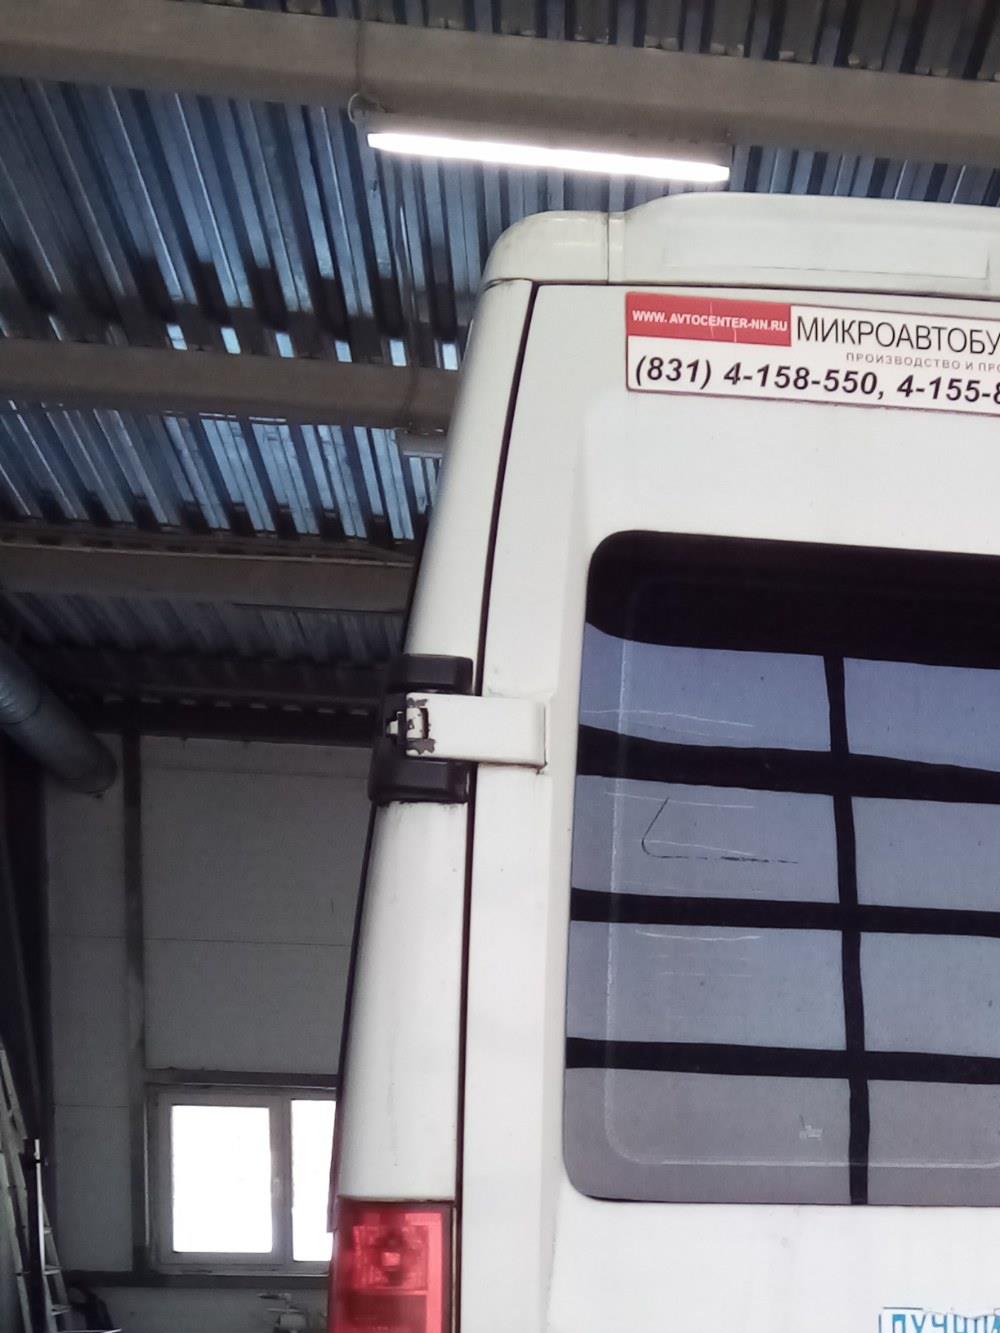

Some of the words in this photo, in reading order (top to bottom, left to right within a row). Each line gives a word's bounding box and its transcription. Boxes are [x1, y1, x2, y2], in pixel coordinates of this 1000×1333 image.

[634, 354, 713, 390] (831)
[723, 362, 885, 400] 4-158-550,
[846, 352, 961, 371] ПРОИЗВОДСТВО
[964, 361, 974, 371] И
